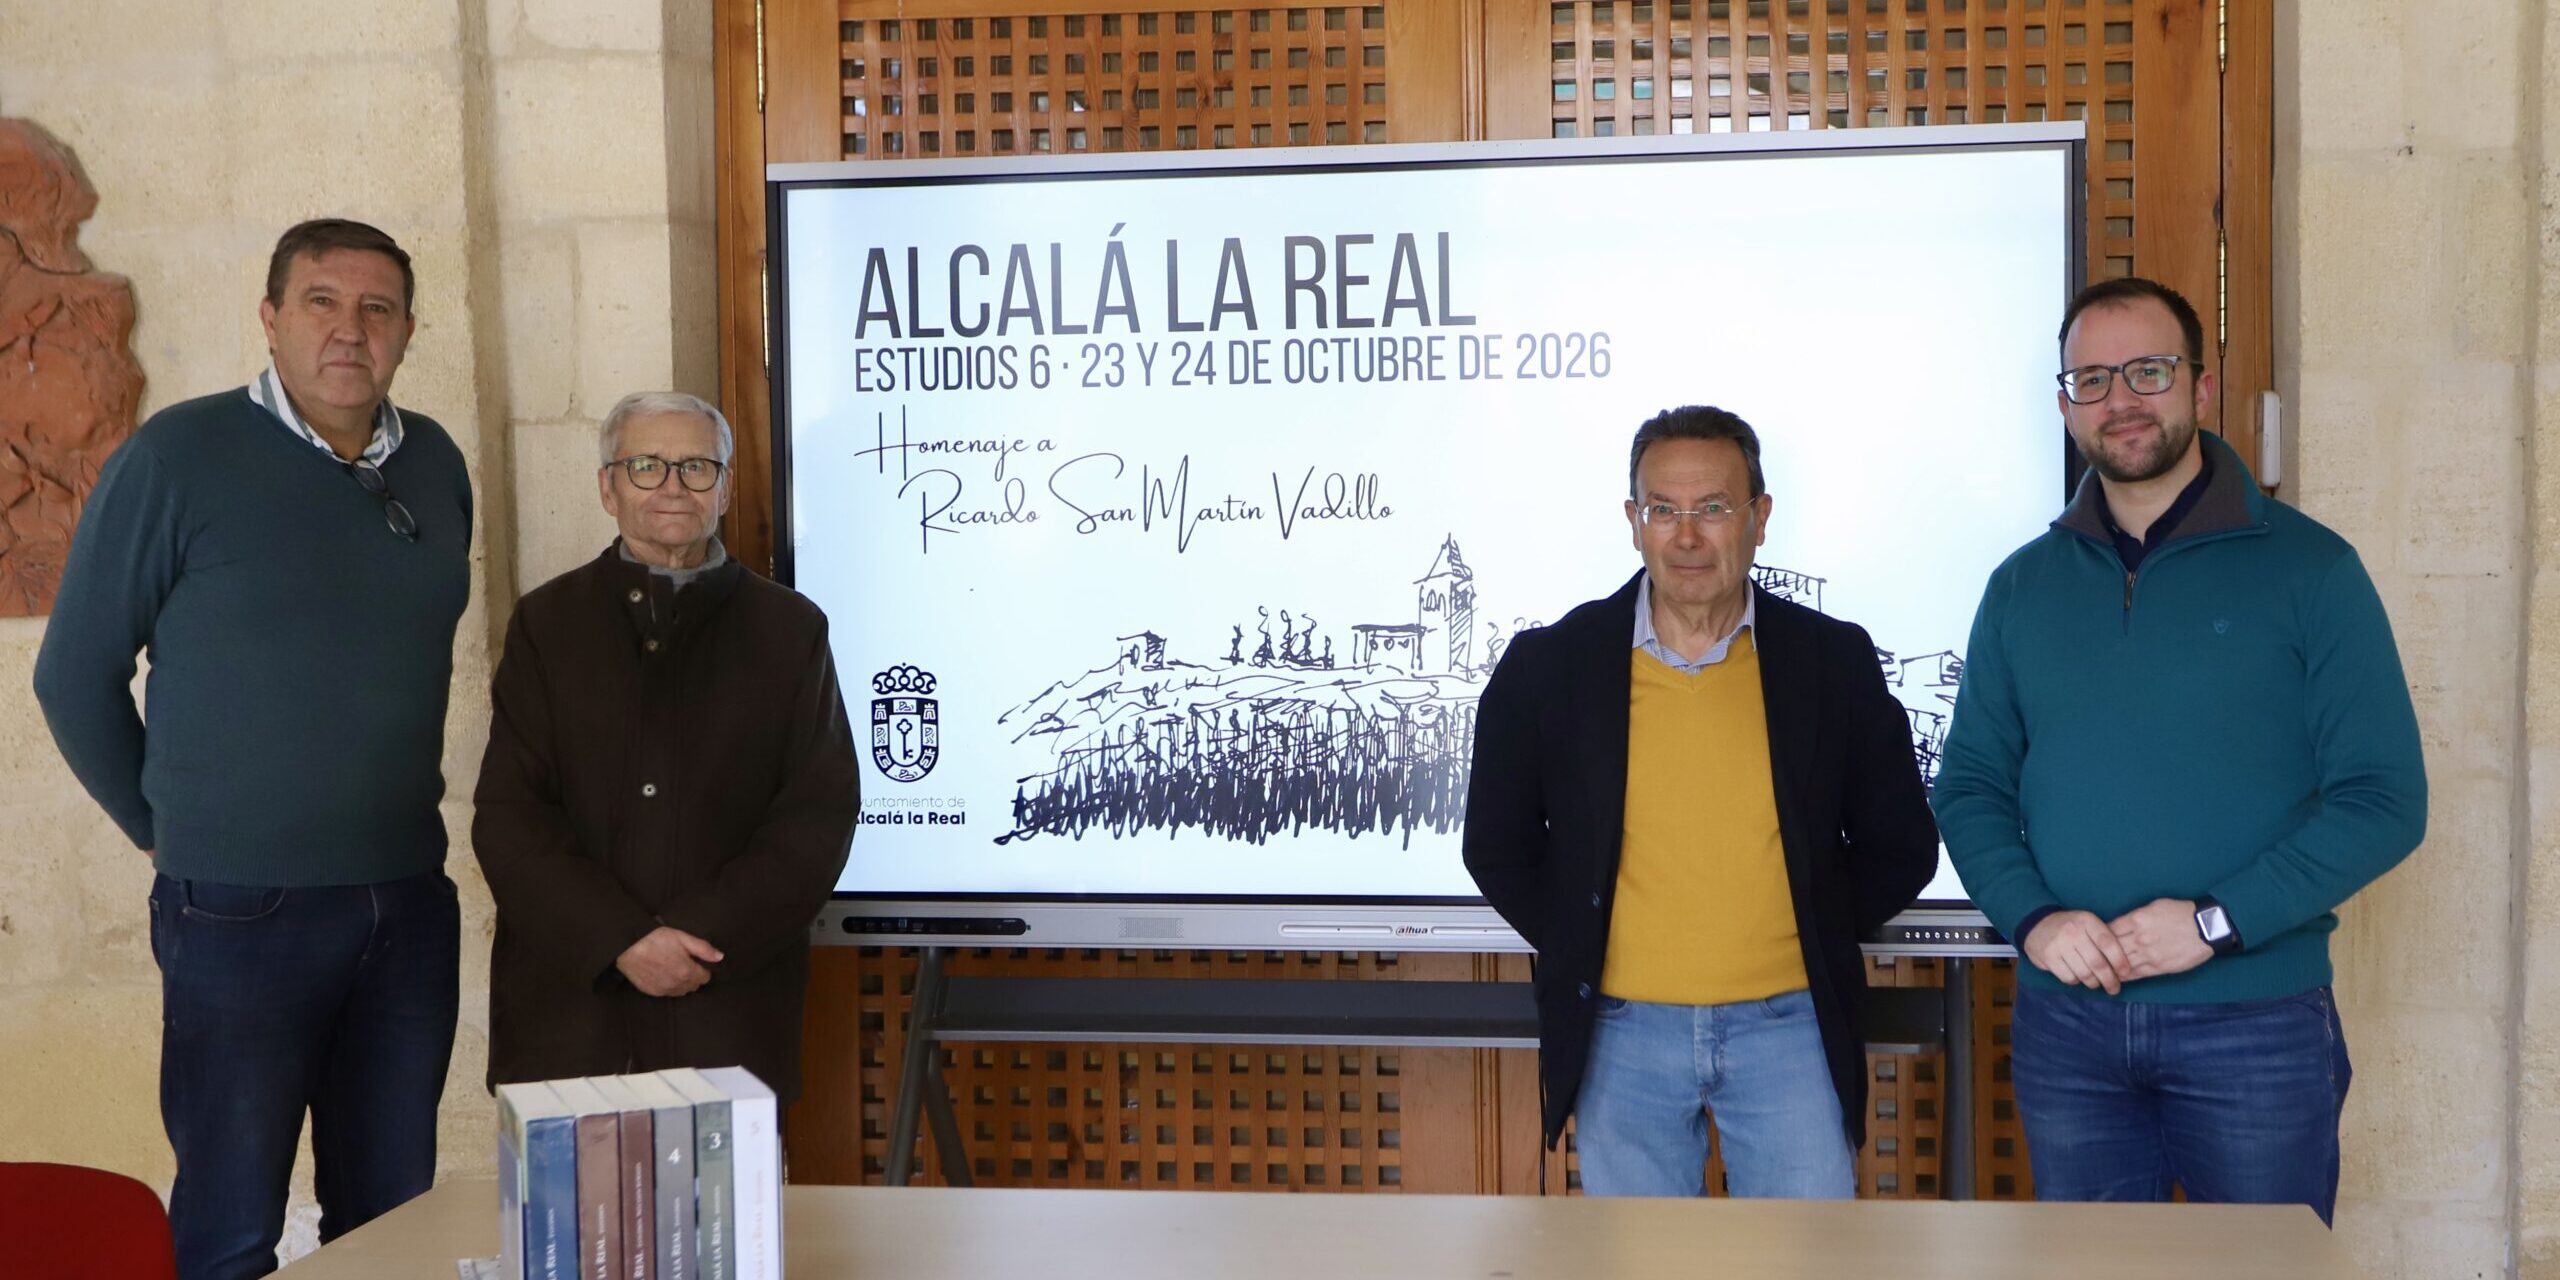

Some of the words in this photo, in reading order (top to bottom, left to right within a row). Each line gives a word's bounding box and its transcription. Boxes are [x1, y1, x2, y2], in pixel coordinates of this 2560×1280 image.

[855, 223, 1141, 340] ALCALÁ
[1166, 237, 1259, 333] LA
[1284, 232, 1477, 330] REAL
[855, 344, 1018, 392] ESTUDIOS
[1029, 346, 1051, 389] 6
[1081, 344, 1125, 388] 23
[1137, 342, 1159, 387] Y
[1171, 342, 1217, 386] 24
[1229, 341, 1272, 385] DE
[1284, 337, 1447, 384] OCTUBRE
[1459, 336, 1503, 380] DE
[1515, 331, 1613, 379] 2026
[854, 404, 1029, 481] Homenaje
[1036, 438, 1057, 453] a
[898, 468, 1040, 556] Ricardo
[1048, 452, 1136, 536] San
[1272, 464, 1395, 540] Vadillo
[857, 810, 904, 825] lcalá
[908, 810, 924, 825] la
[928, 811, 965, 825] Real
[860, 796, 943, 808] untamiento
[948, 796, 965, 807] de
[667, 1147, 681, 1165] 4
[709, 1131, 722, 1150] 3
